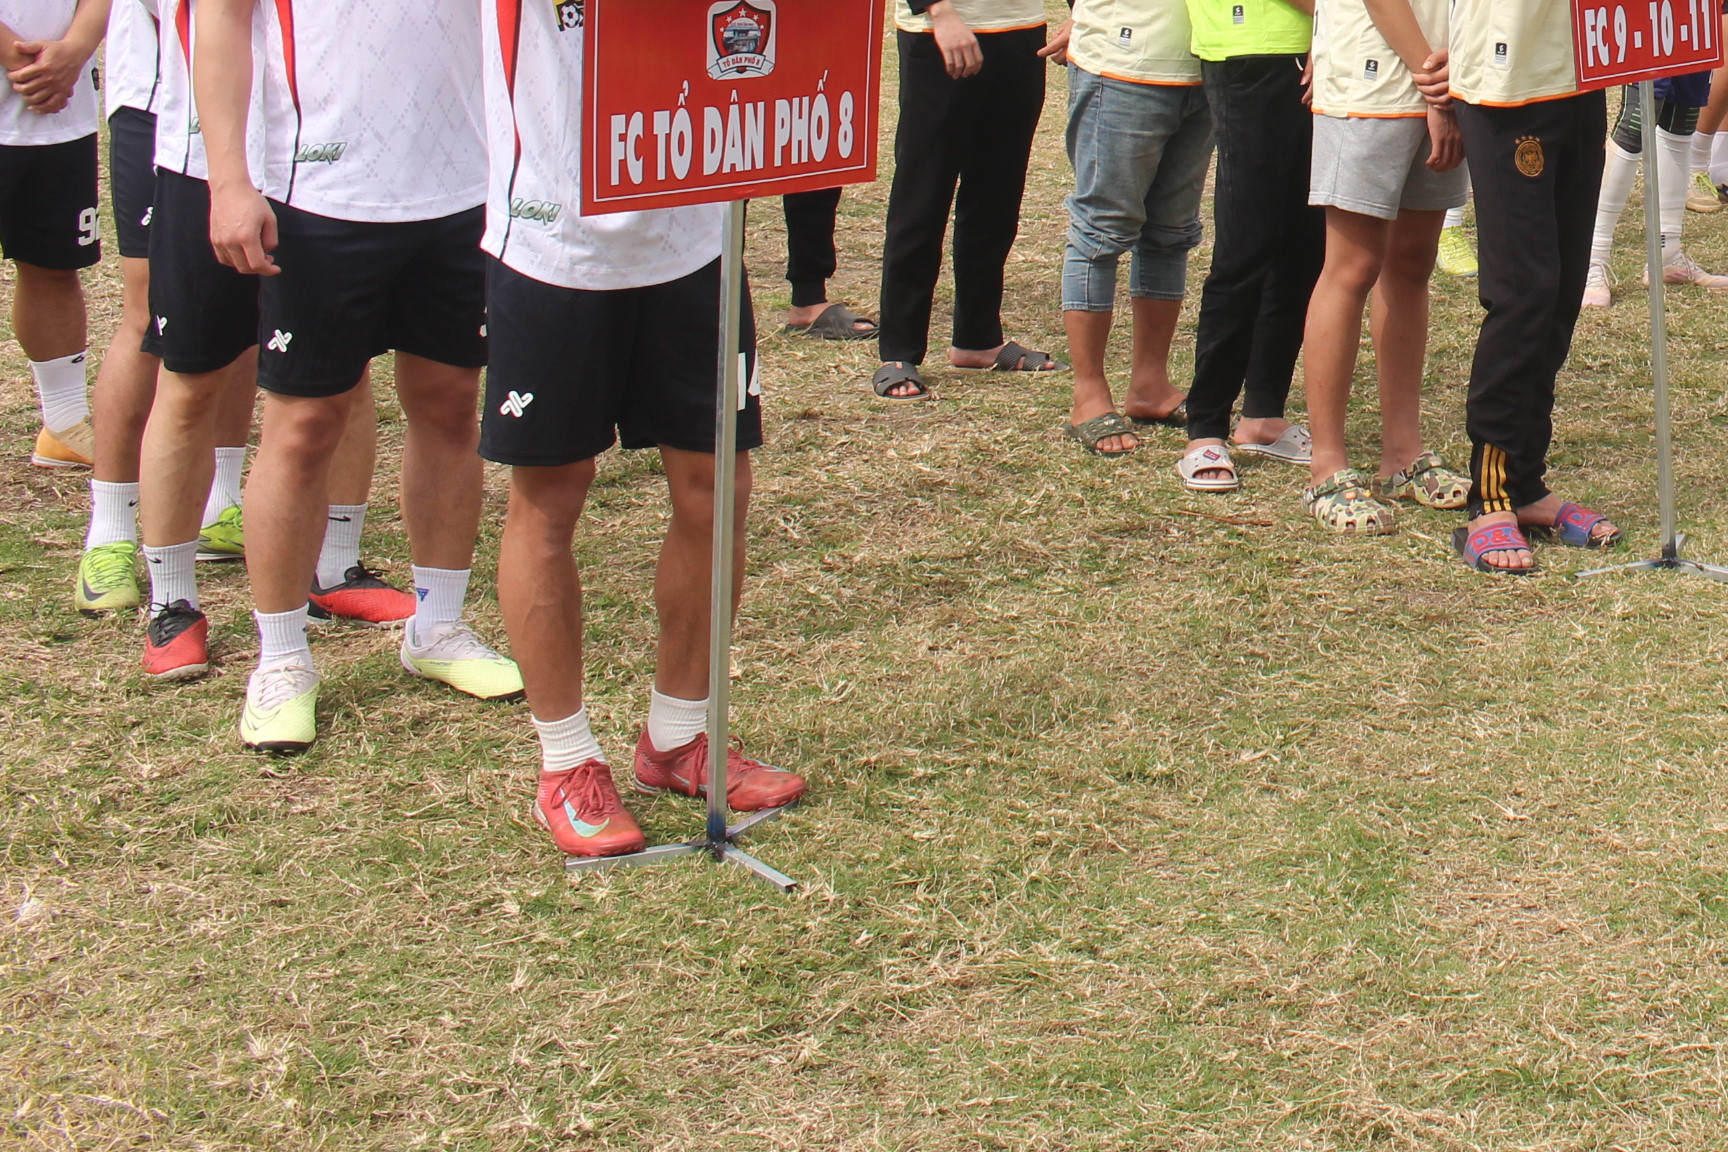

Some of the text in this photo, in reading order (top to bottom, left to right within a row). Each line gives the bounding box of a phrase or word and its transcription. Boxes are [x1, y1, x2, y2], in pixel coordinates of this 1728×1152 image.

[1584, 6, 1610, 68] FC
[1613, 5, 1627, 63] 9
[1649, 0, 1674, 57] 10
[732, 55, 743, 65] DÂN
[610, 69, 855, 185] FC TỔ DÂN PHỐ 8
[294, 141, 348, 165] LOKI
[511, 198, 562, 226] LOKI
